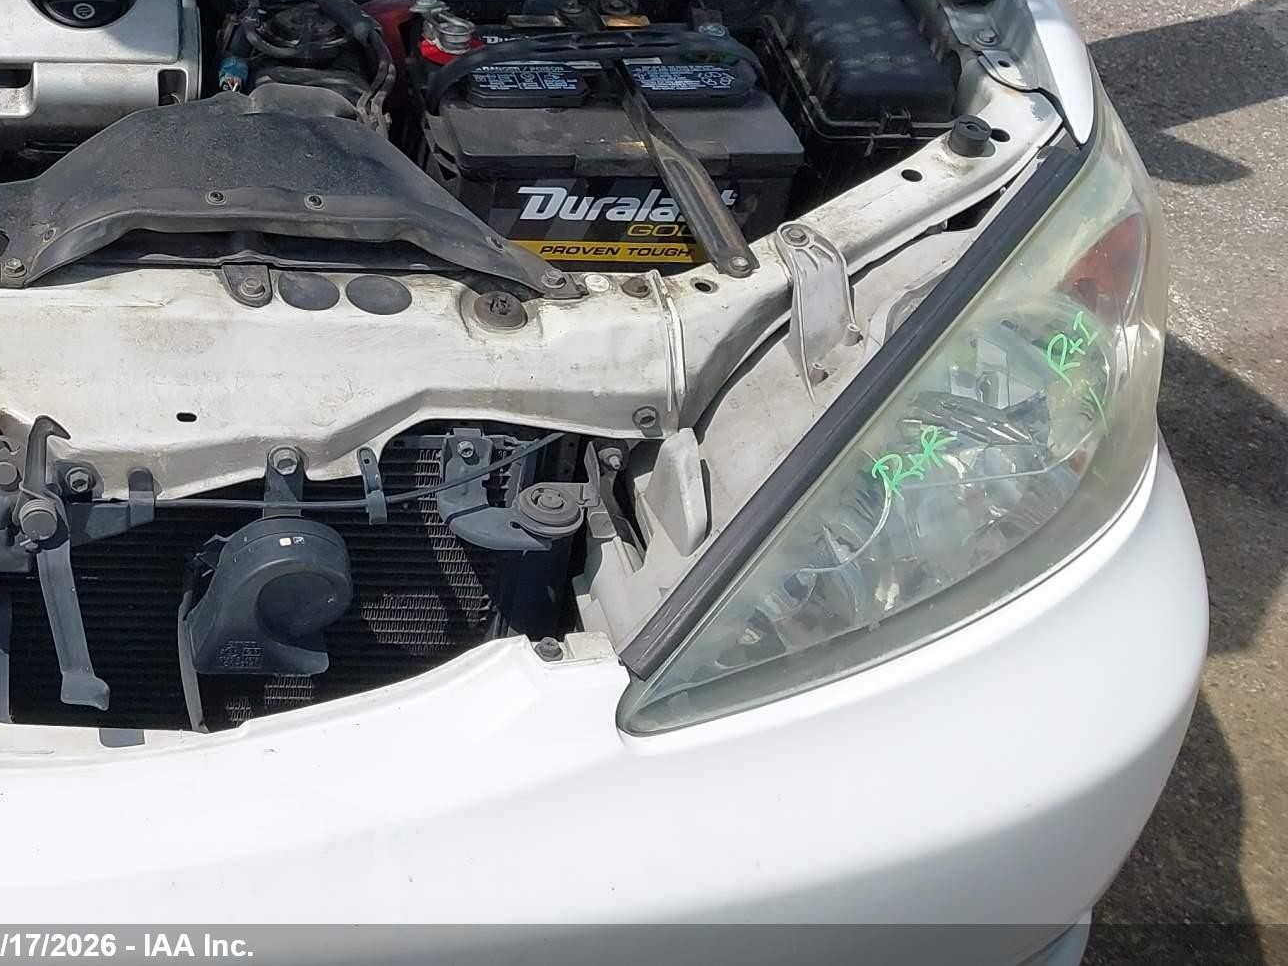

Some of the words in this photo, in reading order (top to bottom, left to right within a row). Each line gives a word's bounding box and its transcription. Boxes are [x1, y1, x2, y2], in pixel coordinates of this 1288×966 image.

[517, 186, 736, 221] Durala
[539, 245, 621, 256] PROVEN
[627, 247, 693, 257] TOUGH
